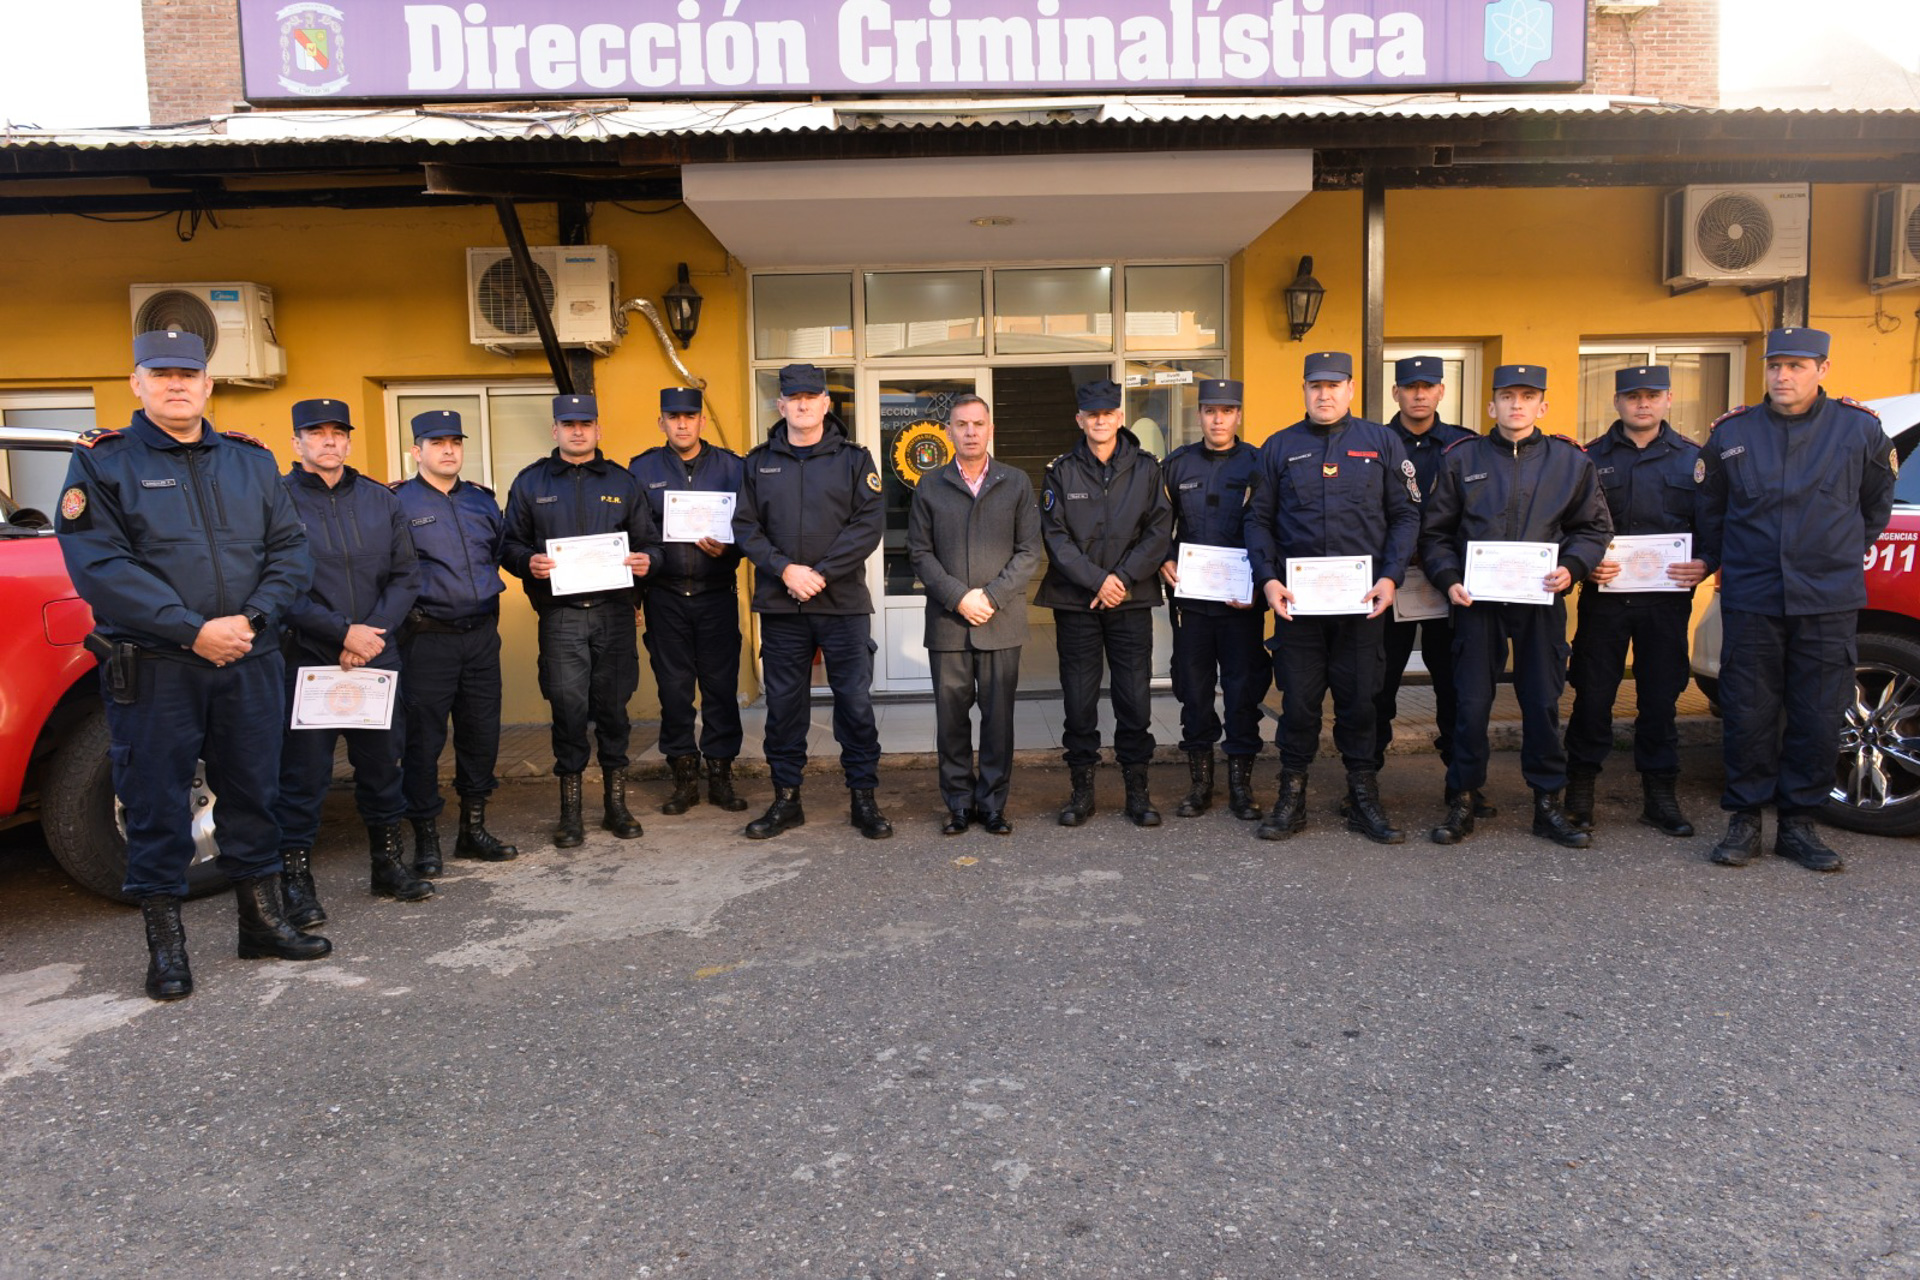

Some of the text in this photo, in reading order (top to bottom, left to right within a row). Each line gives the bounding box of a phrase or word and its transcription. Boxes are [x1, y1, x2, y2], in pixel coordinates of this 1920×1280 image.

[405, 0, 1428, 91] Dirección Criminalística
[1863, 543, 1916, 572] 911
